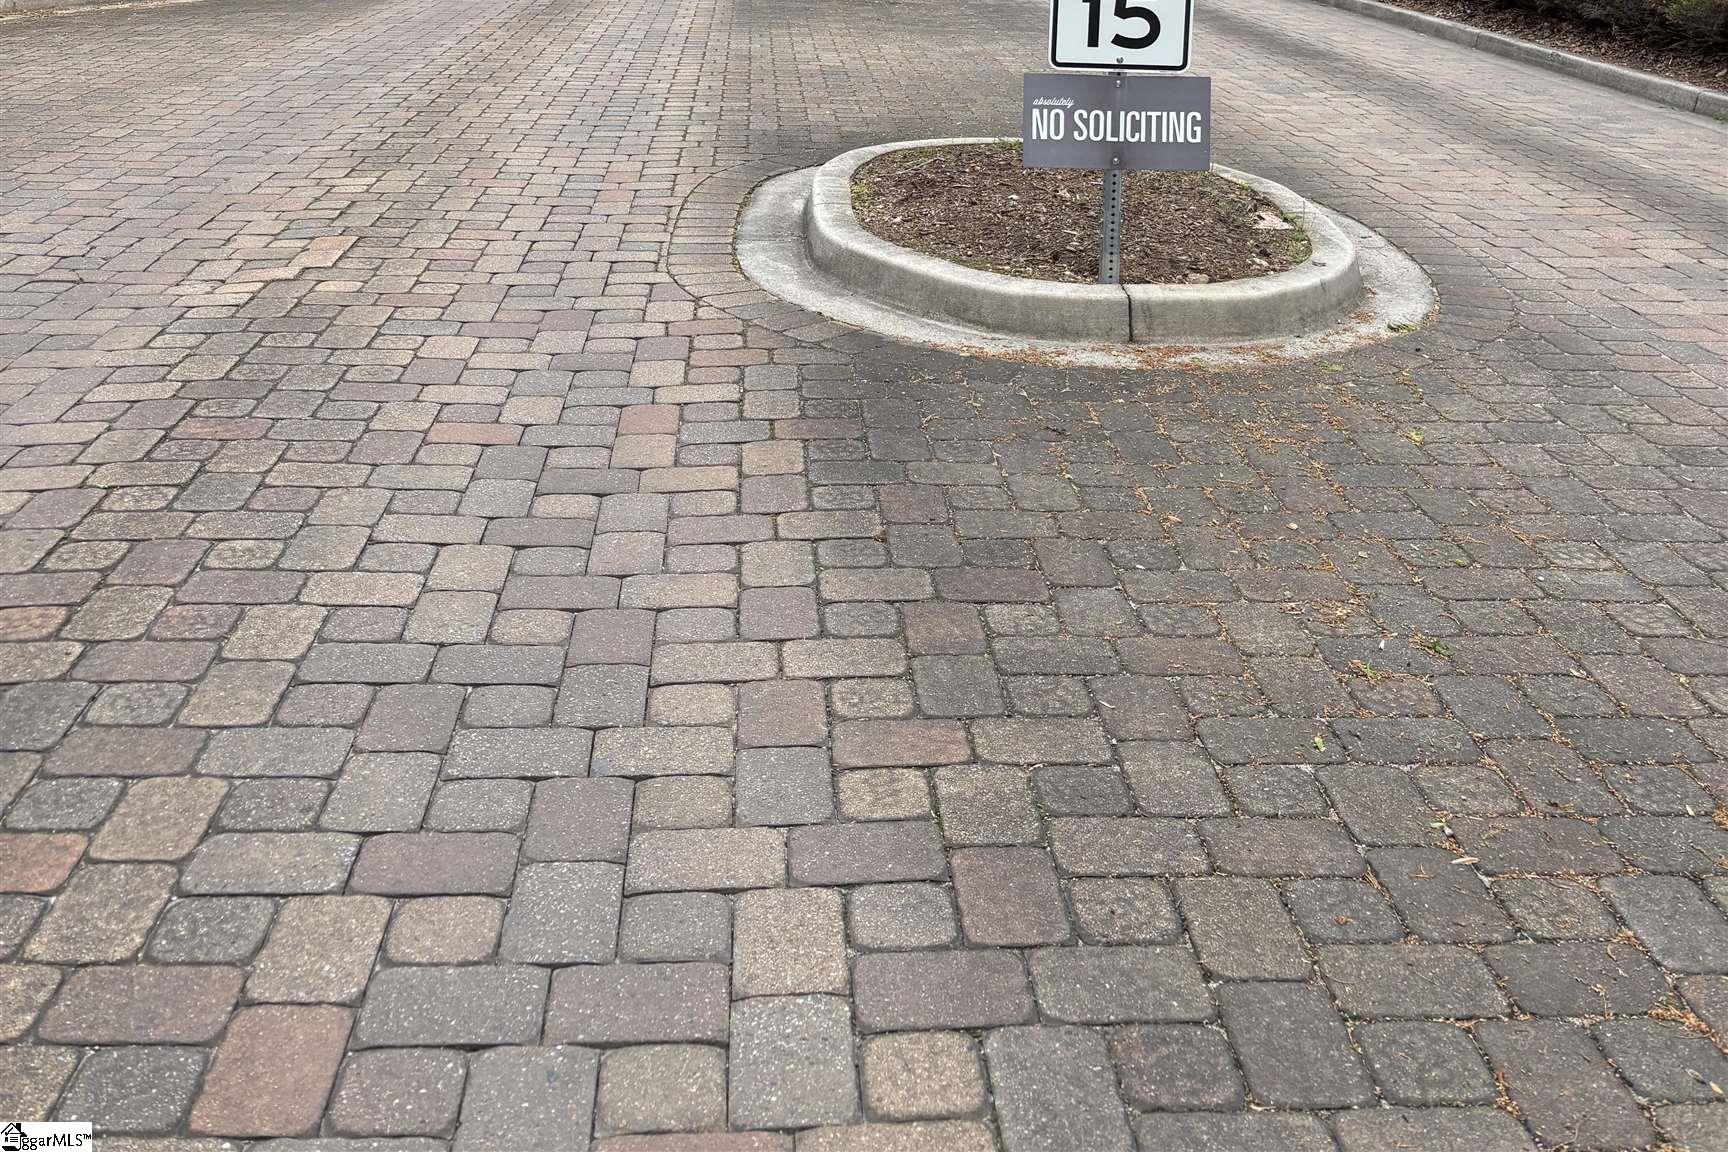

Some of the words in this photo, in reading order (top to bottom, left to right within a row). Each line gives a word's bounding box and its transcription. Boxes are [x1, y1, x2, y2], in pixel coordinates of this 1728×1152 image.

[1033, 96, 1074, 108] absolutely
[1032, 108, 1065, 140] NO
[1073, 109, 1202, 143] SOLICITING
